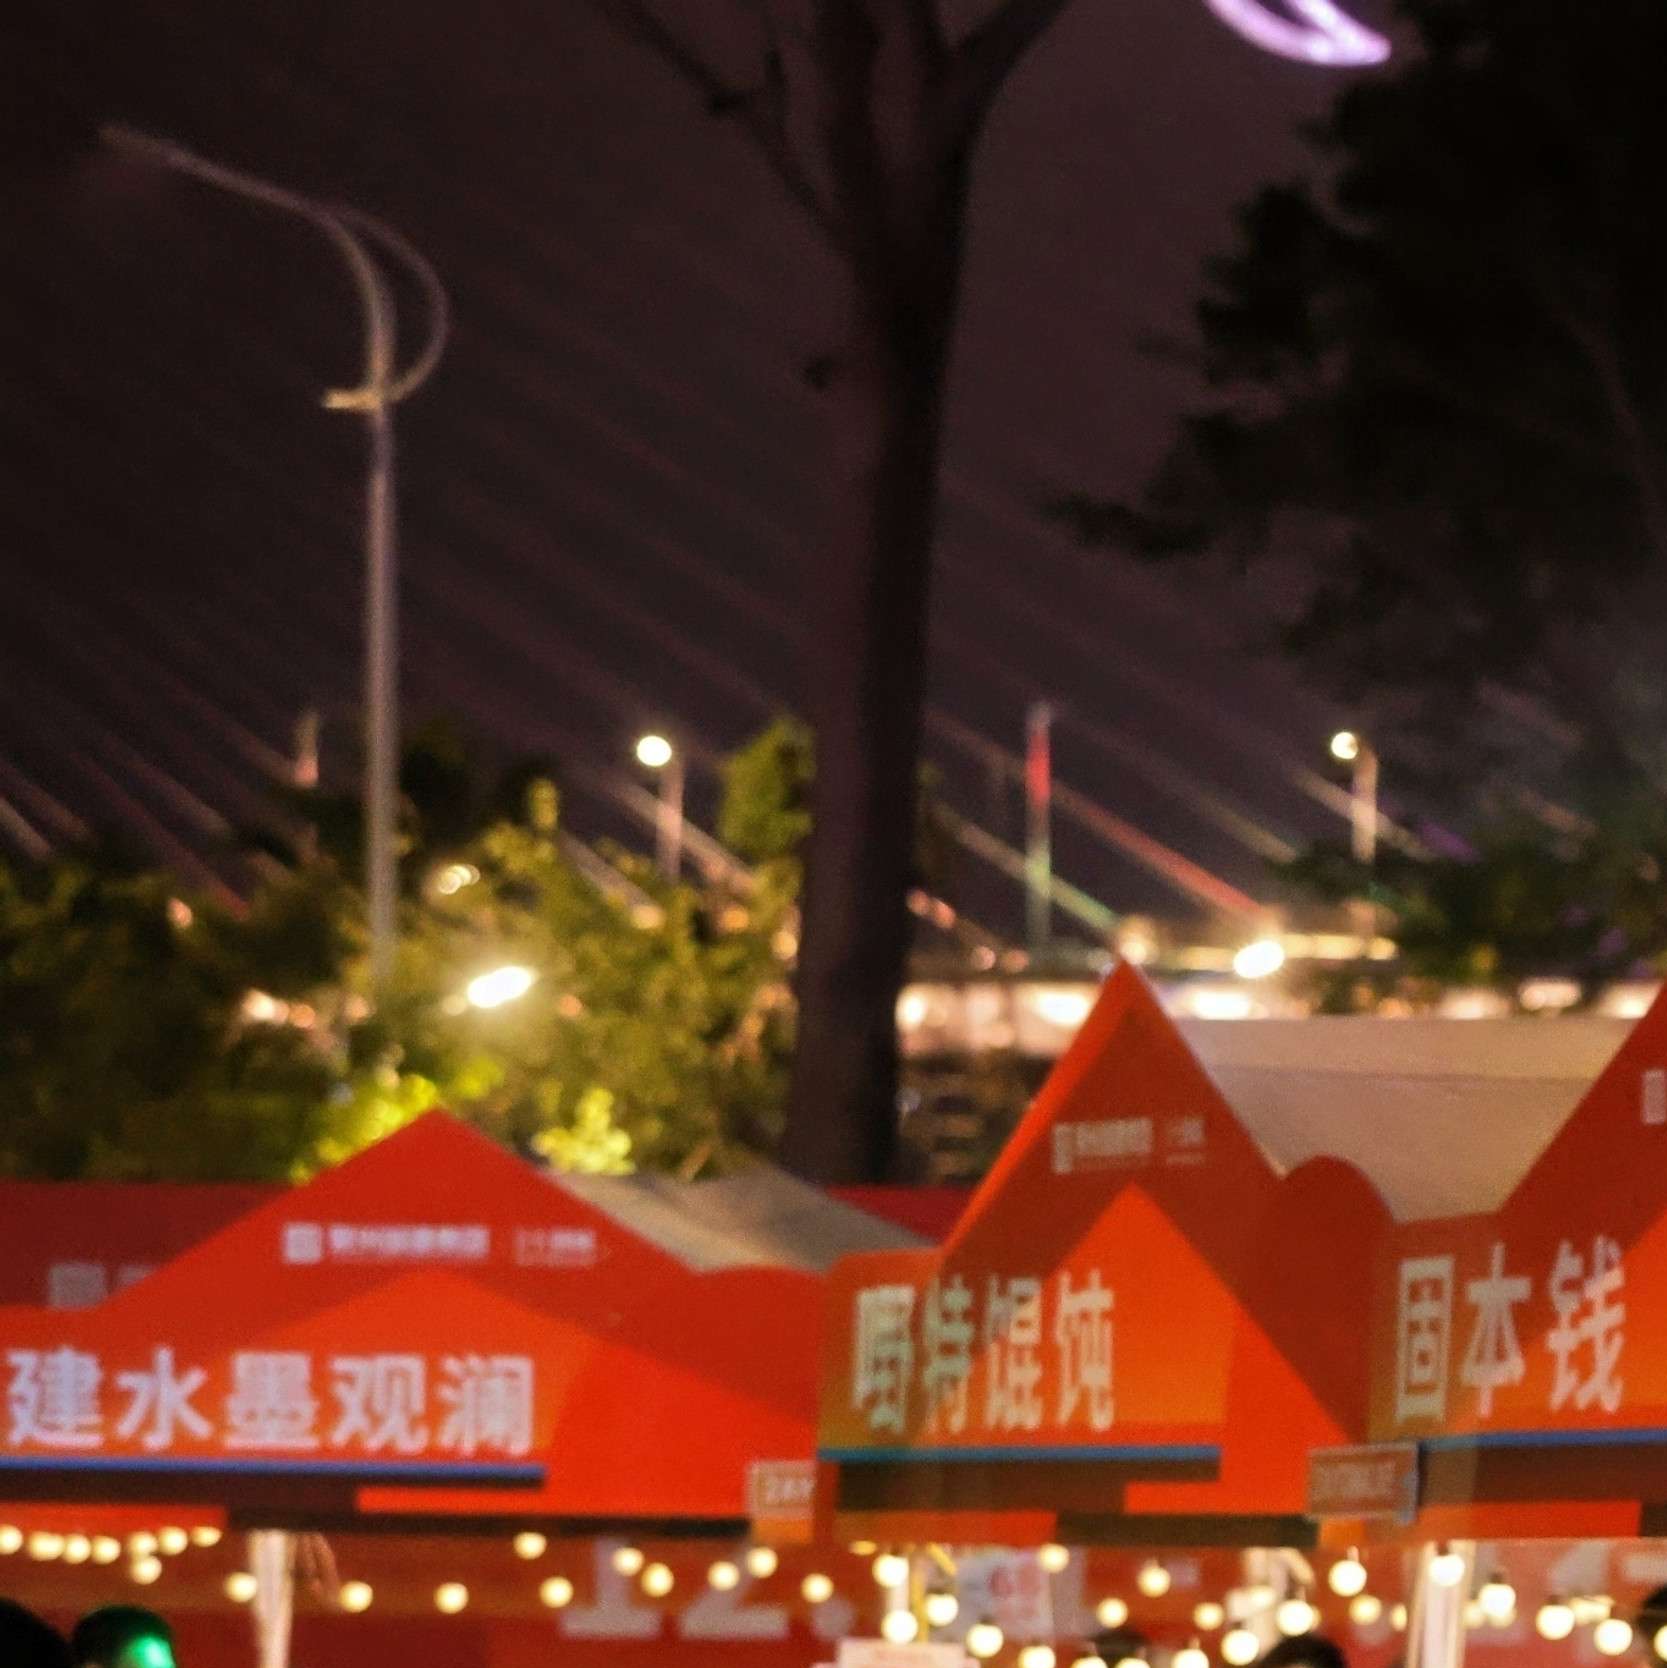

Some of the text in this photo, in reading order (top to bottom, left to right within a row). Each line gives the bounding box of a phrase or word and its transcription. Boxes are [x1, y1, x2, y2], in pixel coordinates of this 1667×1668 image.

[4, 1344, 535, 1457] 建水墨观澜
[1394, 1234, 1626, 1425] 固本钱
